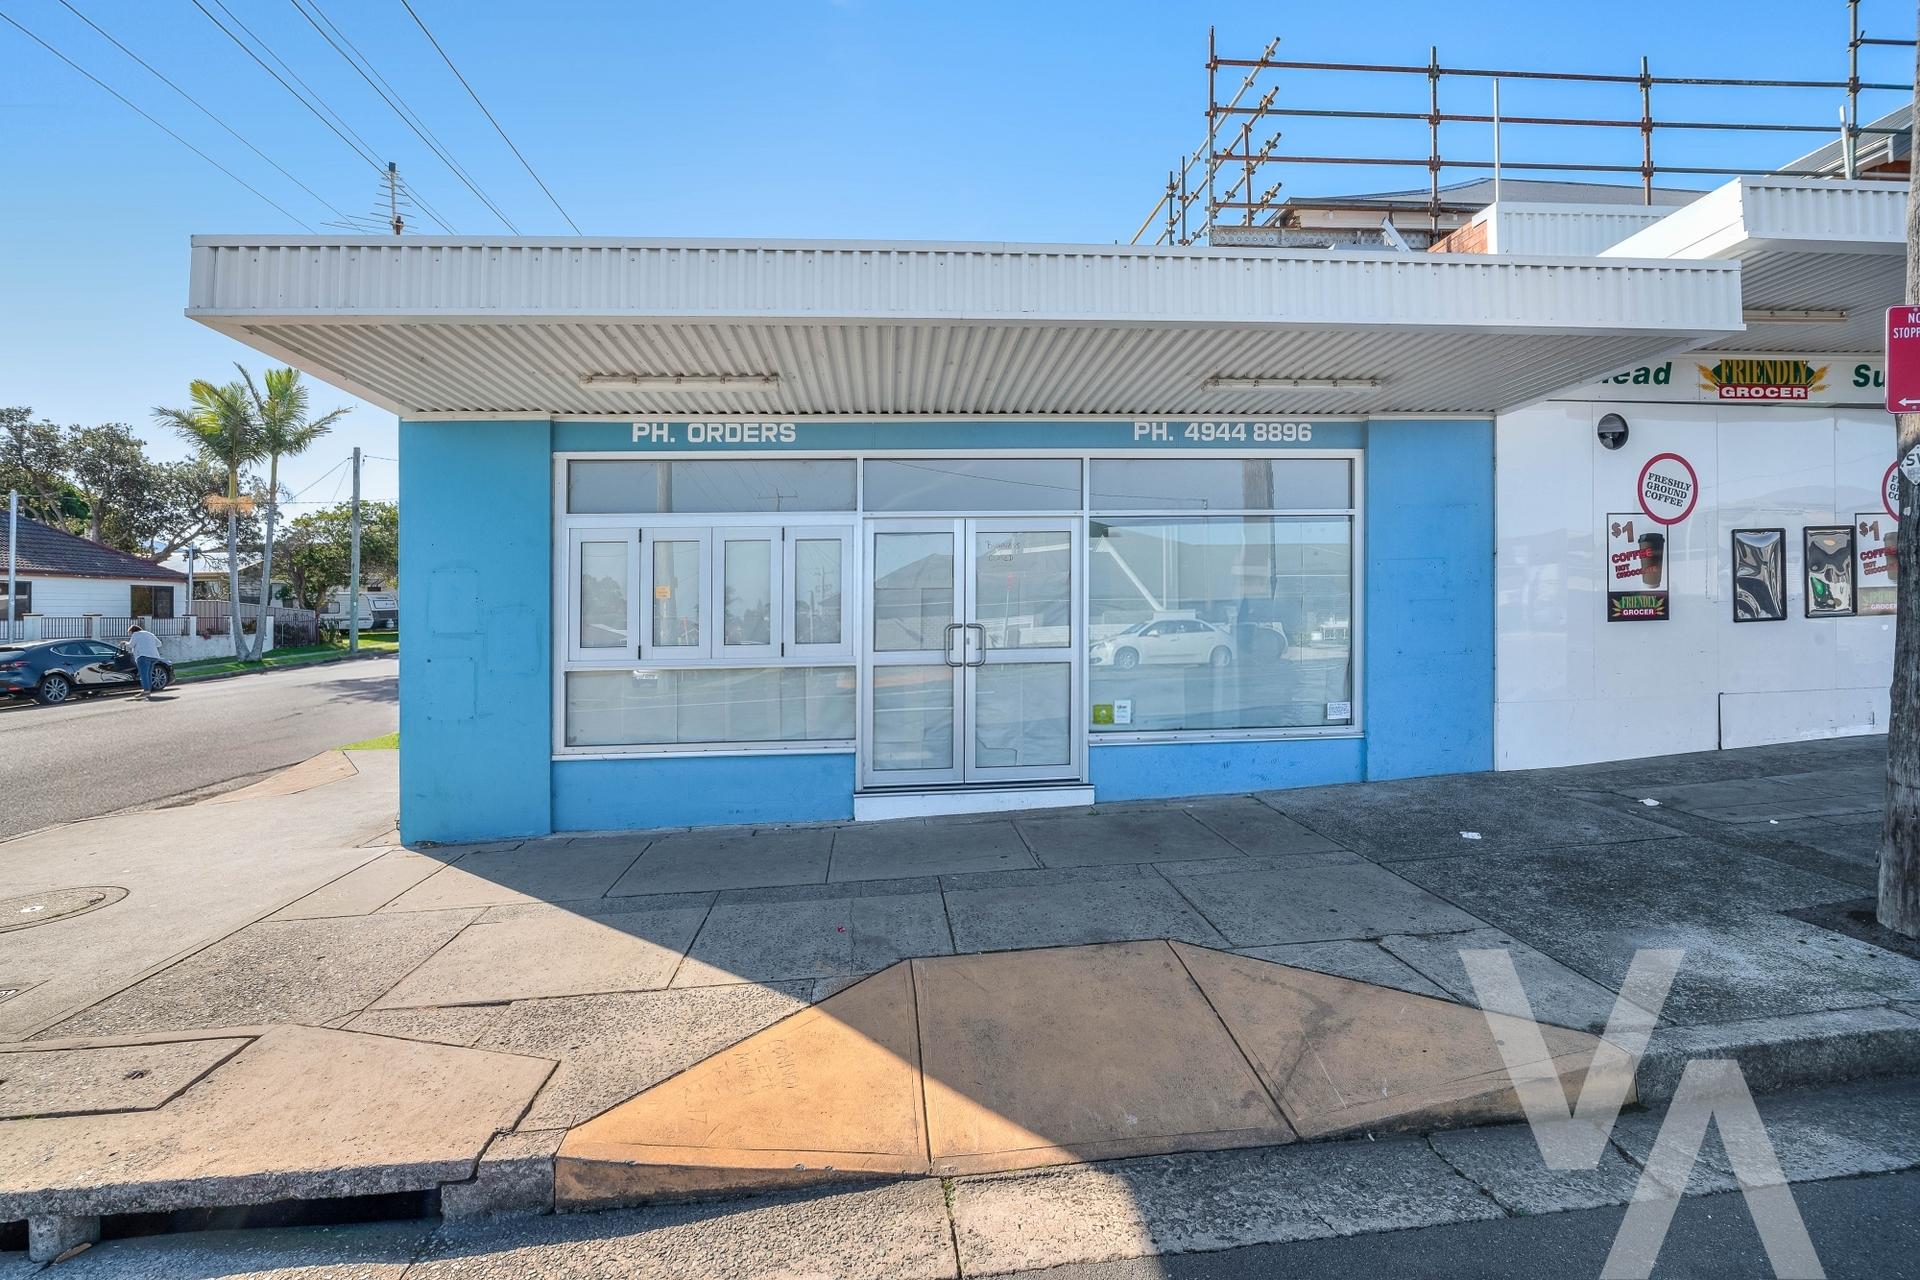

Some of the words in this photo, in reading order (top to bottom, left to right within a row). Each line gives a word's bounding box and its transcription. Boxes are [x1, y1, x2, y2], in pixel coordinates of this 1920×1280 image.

[1602, 361, 1673, 386] ead
[1720, 359, 1809, 385] FRIENDLY
[1721, 386, 1806, 398] GROCER
[632, 423, 676, 443] PH.
[687, 423, 797, 443] ORDERS
[1134, 422, 1174, 441] PH.
[1184, 422, 1247, 442] 4944
[1253, 423, 1312, 442] 8896
[1646, 481, 1688, 500] GROUND
[1648, 472, 1692, 491] FRESHLY
[1645, 490, 1684, 507] COFFEE
[1611, 520, 1635, 543] $1
[1859, 520, 1880, 541] $1
[1623, 608, 1655, 616] GROCER
